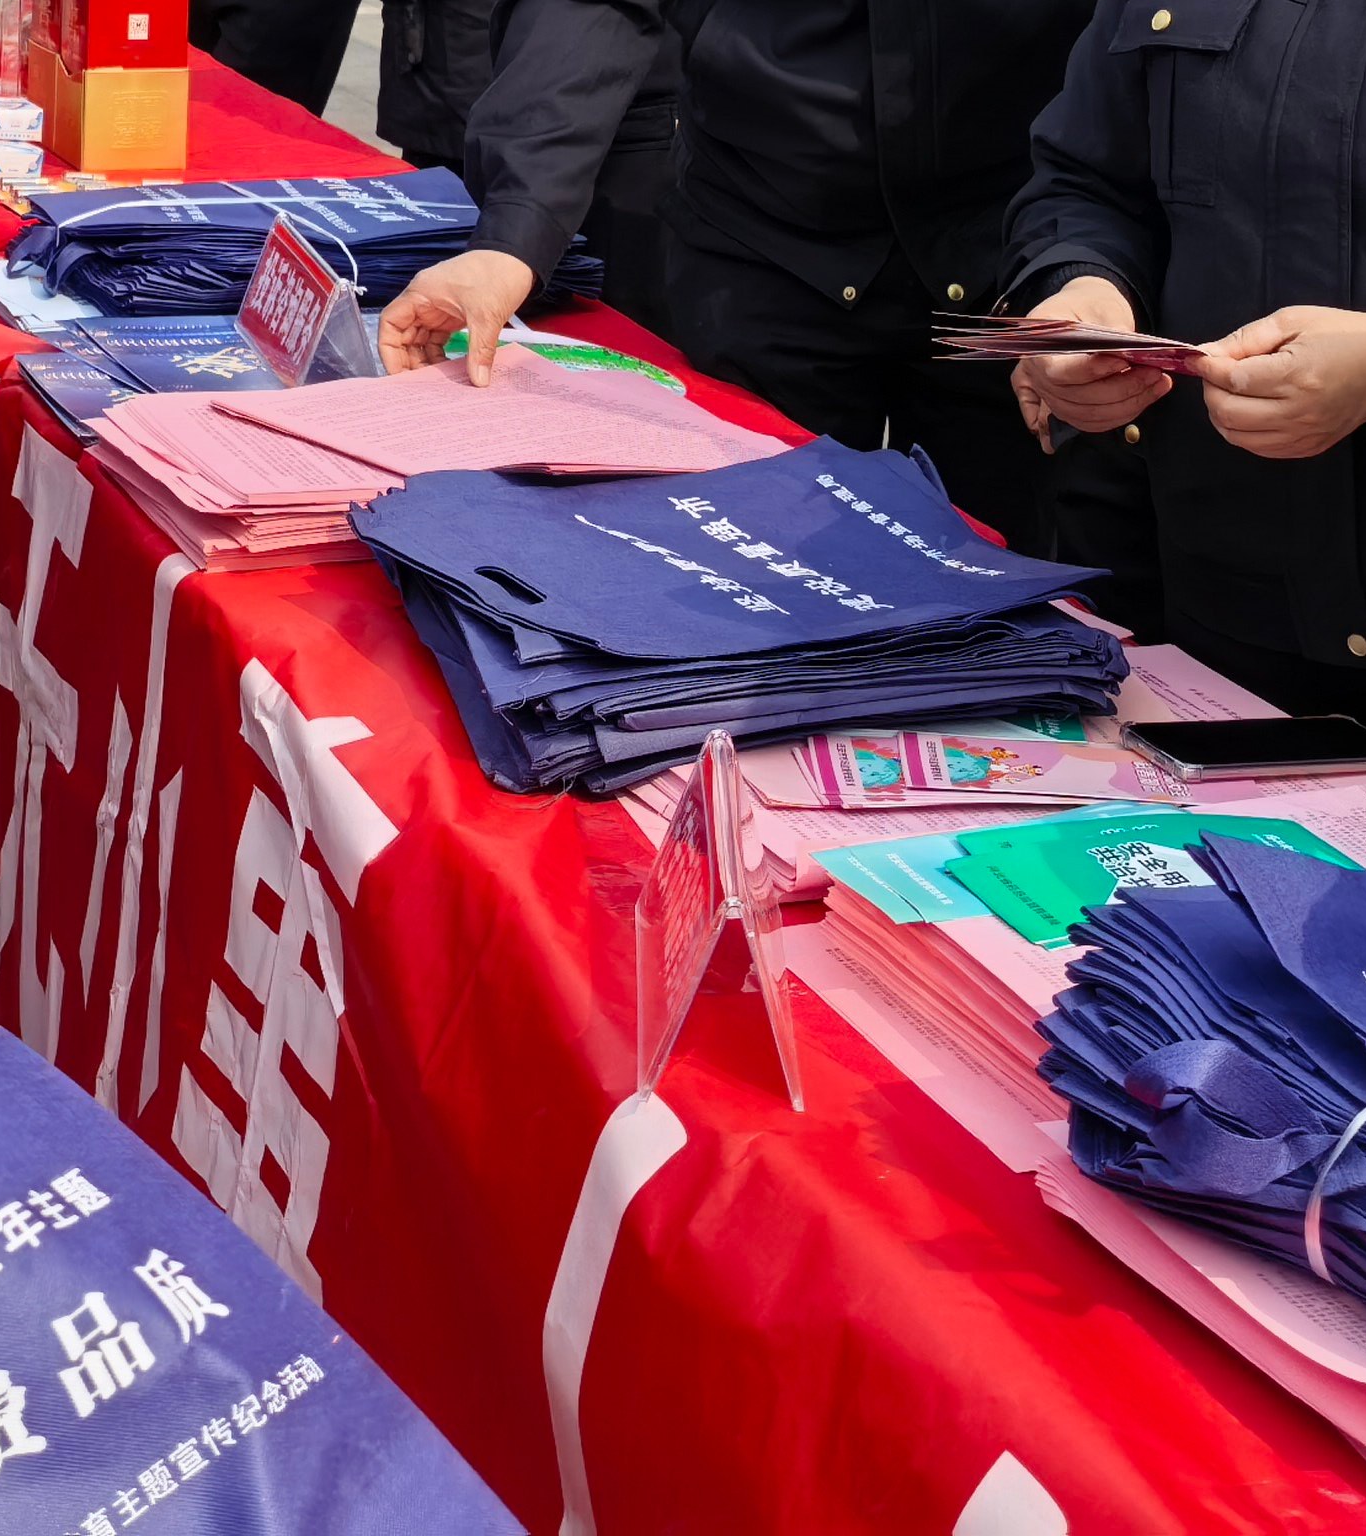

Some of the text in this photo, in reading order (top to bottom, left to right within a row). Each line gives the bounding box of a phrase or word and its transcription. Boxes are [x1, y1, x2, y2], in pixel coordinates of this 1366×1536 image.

[63, 1352, 325, 1536] 育主题宣传纪念活动
